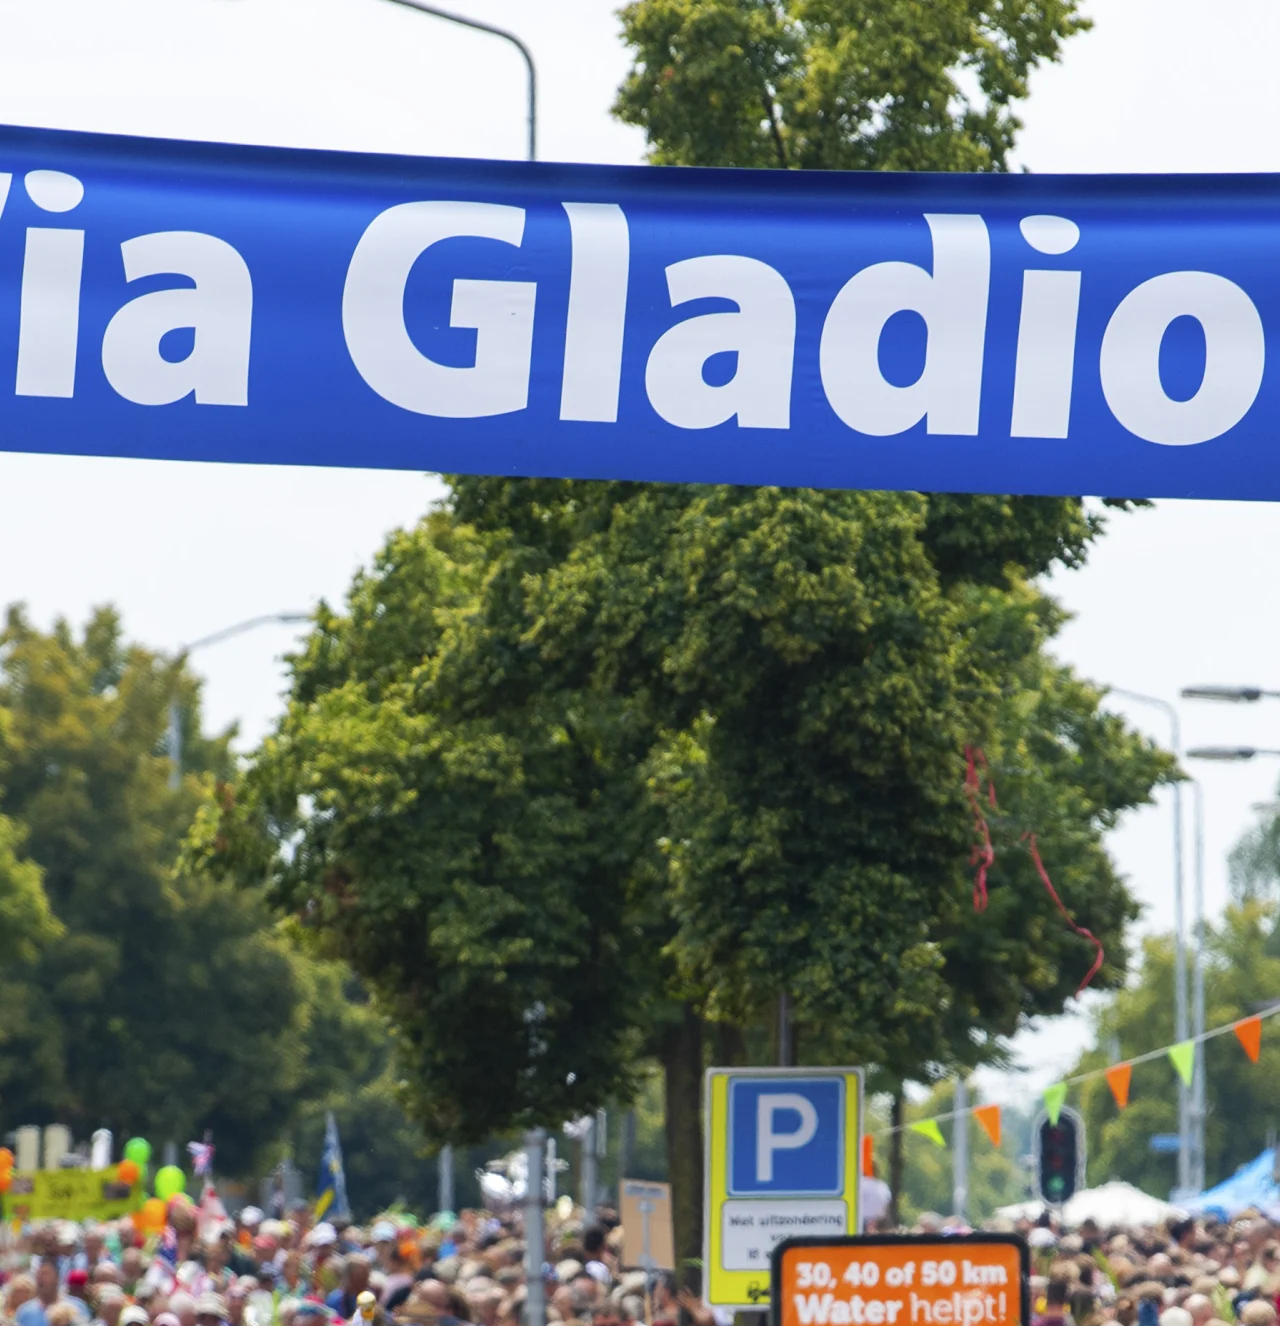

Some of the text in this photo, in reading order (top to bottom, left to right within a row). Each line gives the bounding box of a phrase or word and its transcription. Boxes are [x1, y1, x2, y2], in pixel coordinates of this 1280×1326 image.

[755, 1093, 818, 1183] P
[795, 1259, 1009, 1290] 30, 40 of 50 km
[793, 1292, 904, 1326] Water
